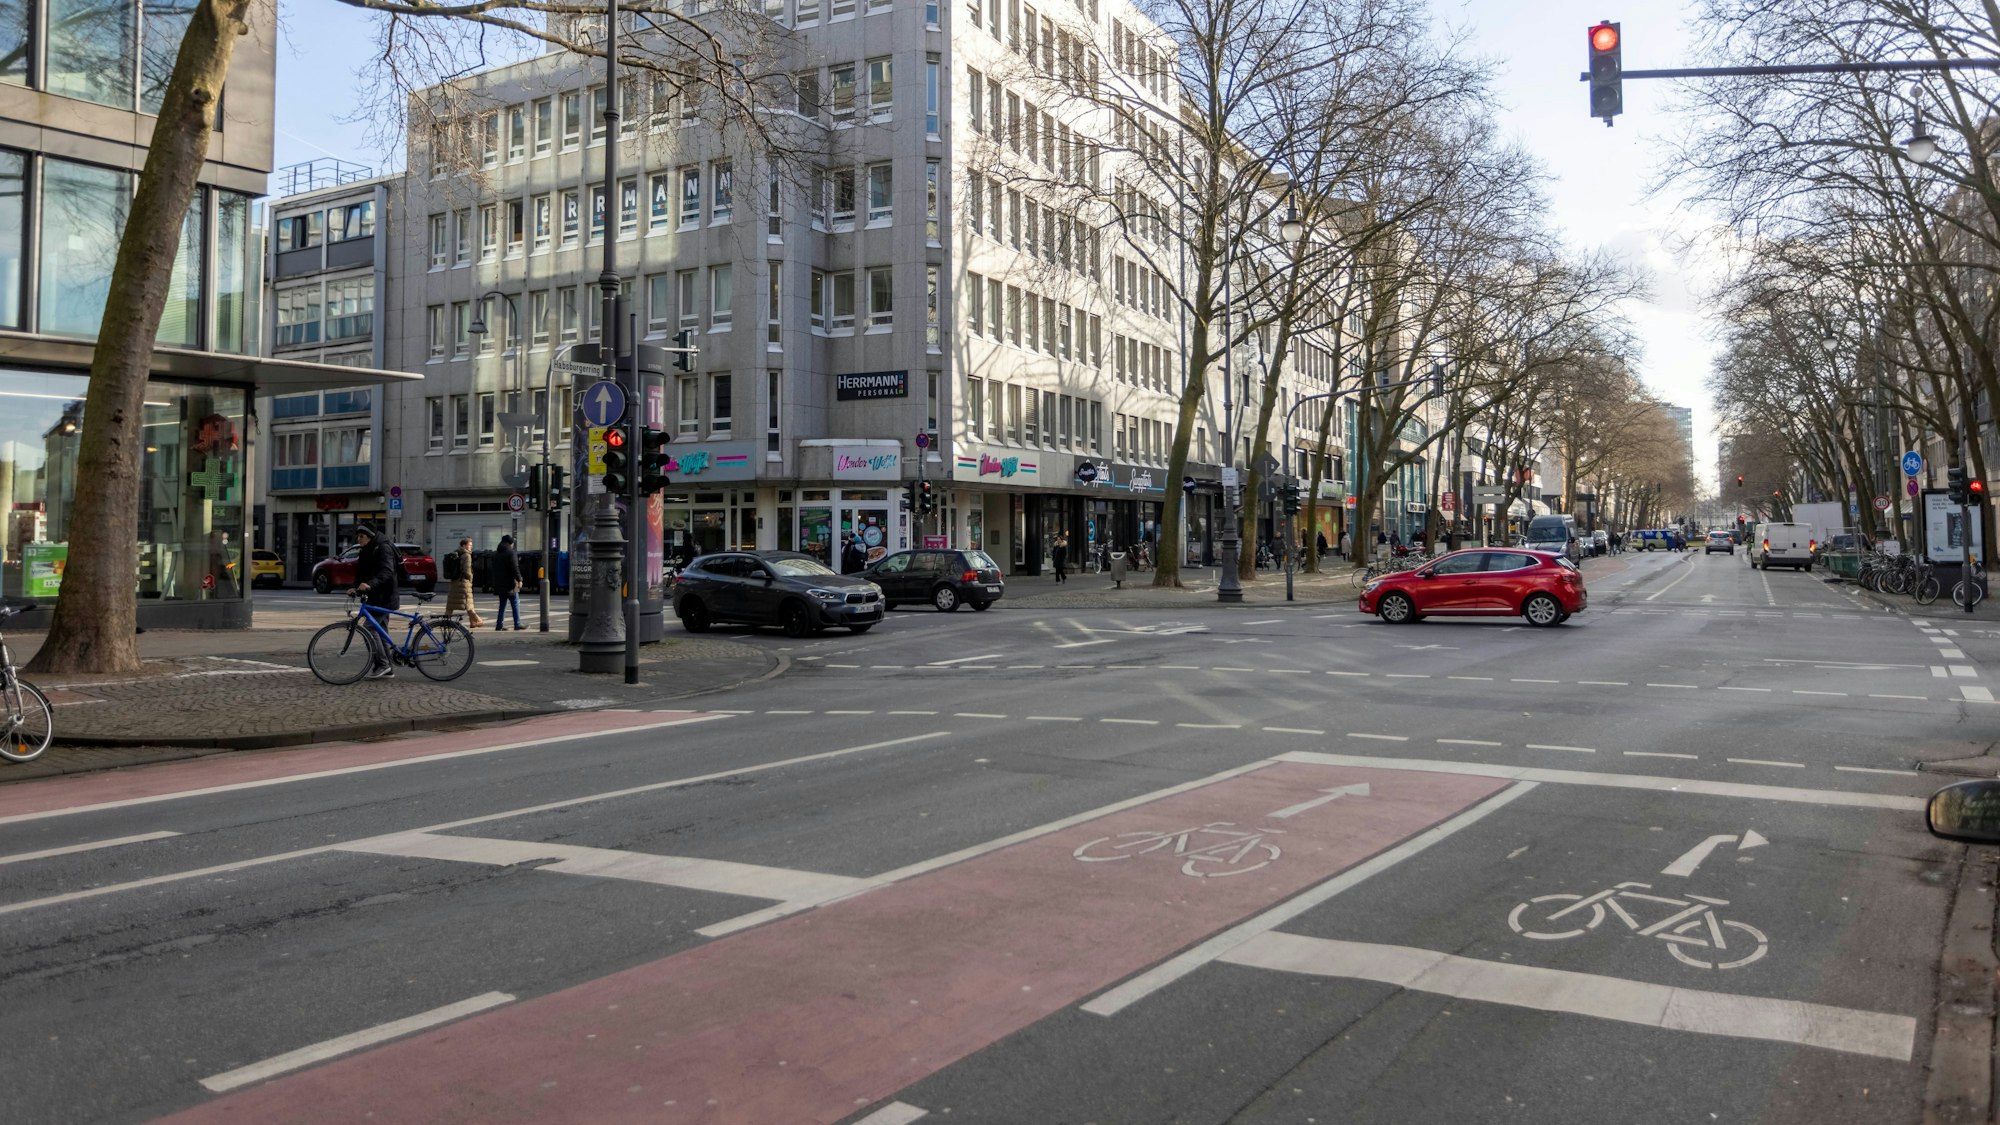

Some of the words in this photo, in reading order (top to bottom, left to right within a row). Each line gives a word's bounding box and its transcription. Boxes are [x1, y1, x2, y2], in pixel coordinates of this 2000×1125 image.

[553, 360, 601, 377] Habsburgerring
[837, 374, 899, 390] HERRMANN
[857, 388, 899, 397] PERSONAL
[511, 498, 521, 507] 30
[1877, 499, 1887, 507] 30
